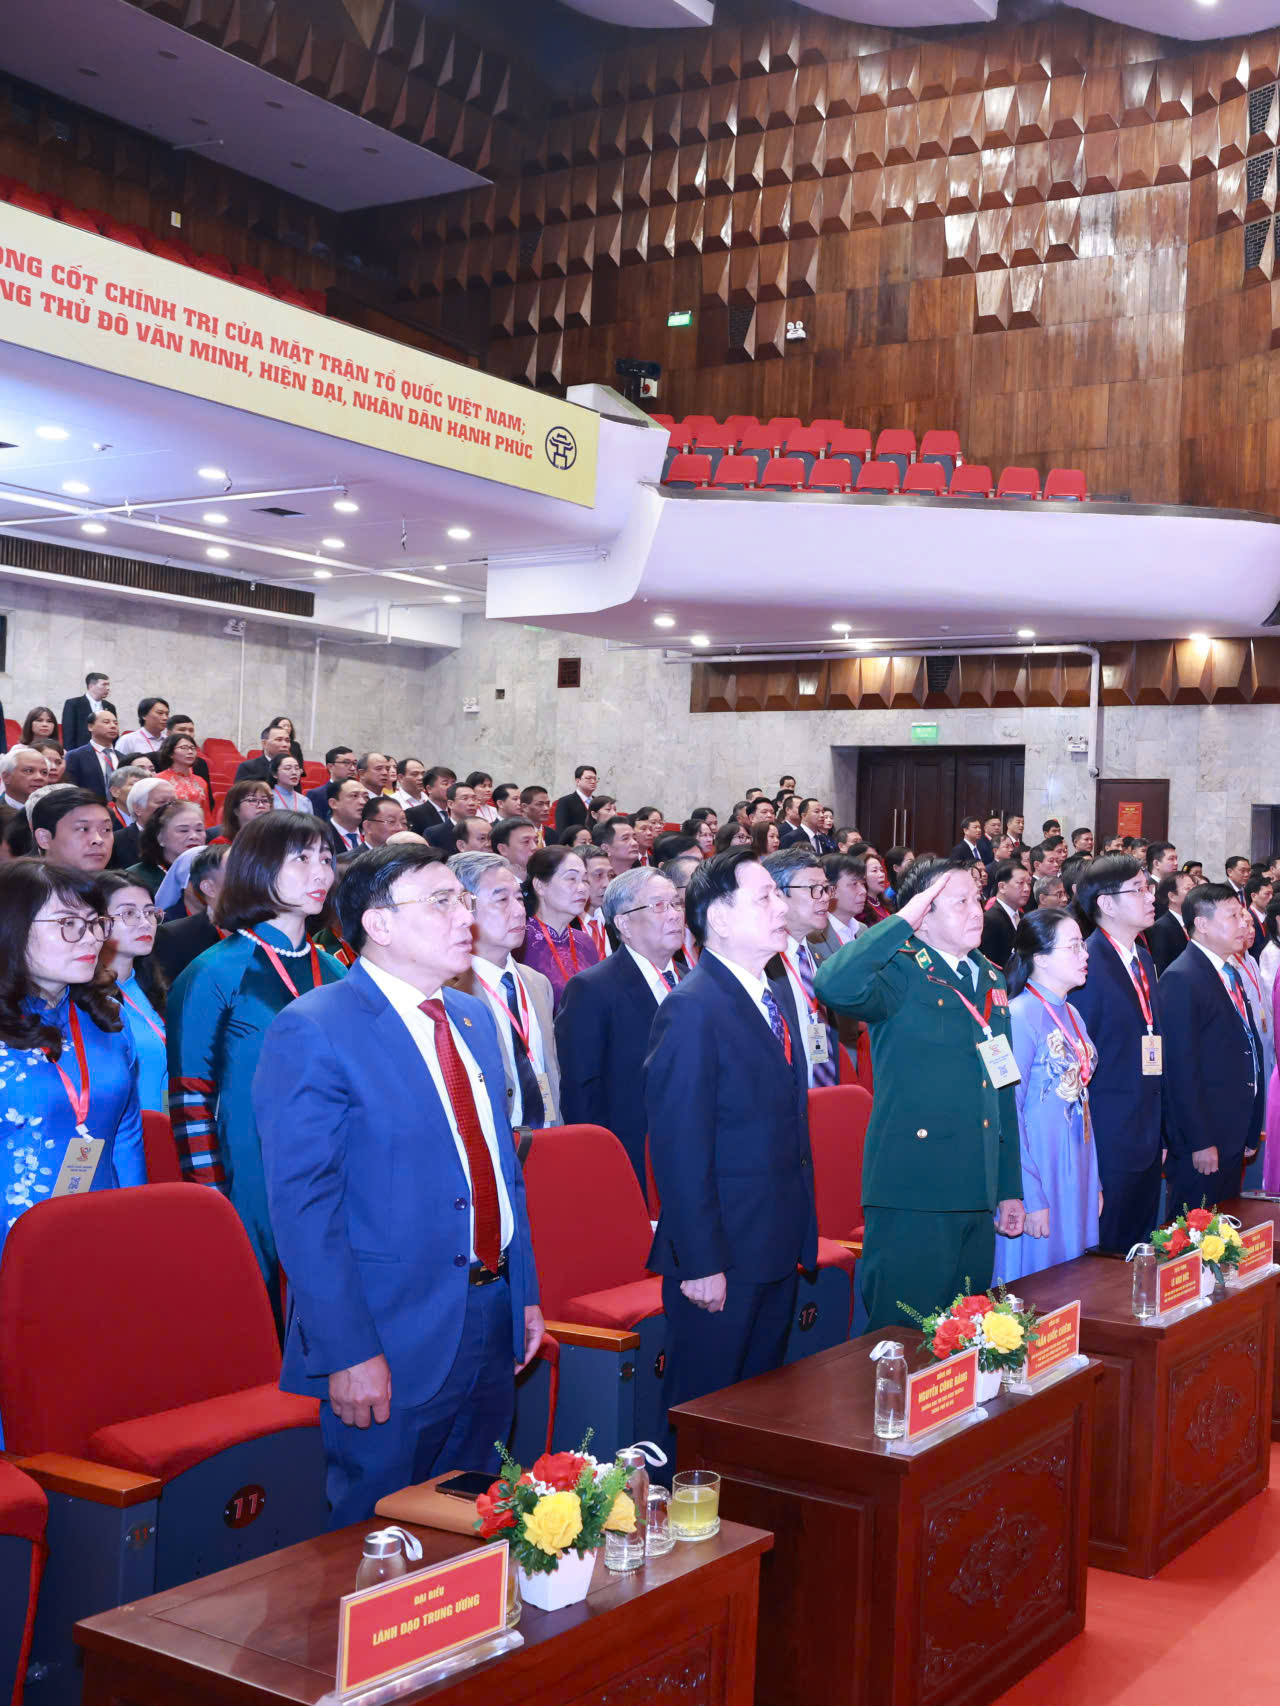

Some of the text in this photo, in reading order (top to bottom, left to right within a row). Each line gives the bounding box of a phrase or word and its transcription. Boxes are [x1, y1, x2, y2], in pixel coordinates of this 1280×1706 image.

[0, 245, 526, 436] NG CỐT CHÍNH TRỊ CỦA MẶT TRẬN TỔ QUỐC VIỆT NAM;
[40, 291, 92, 325] THỦ
[97, 310, 129, 336] ĐÔ
[136, 321, 184, 354] VĂN
[189, 338, 253, 379] MINH,
[259, 361, 307, 392] HIỆN
[311, 377, 347, 408] ĐẠI,
[352, 391, 404, 421] NHÂN
[408, 408, 443, 433] DÂN
[447, 420, 491, 448] HẠNH
[495, 434, 533, 460] PHÚC
[234, 1493, 259, 1520] 11
[400, 1617, 420, 1635] ĐẠO
[422, 1604, 453, 1627] TRUNG
[455, 1593, 480, 1614] ƯƠNG
